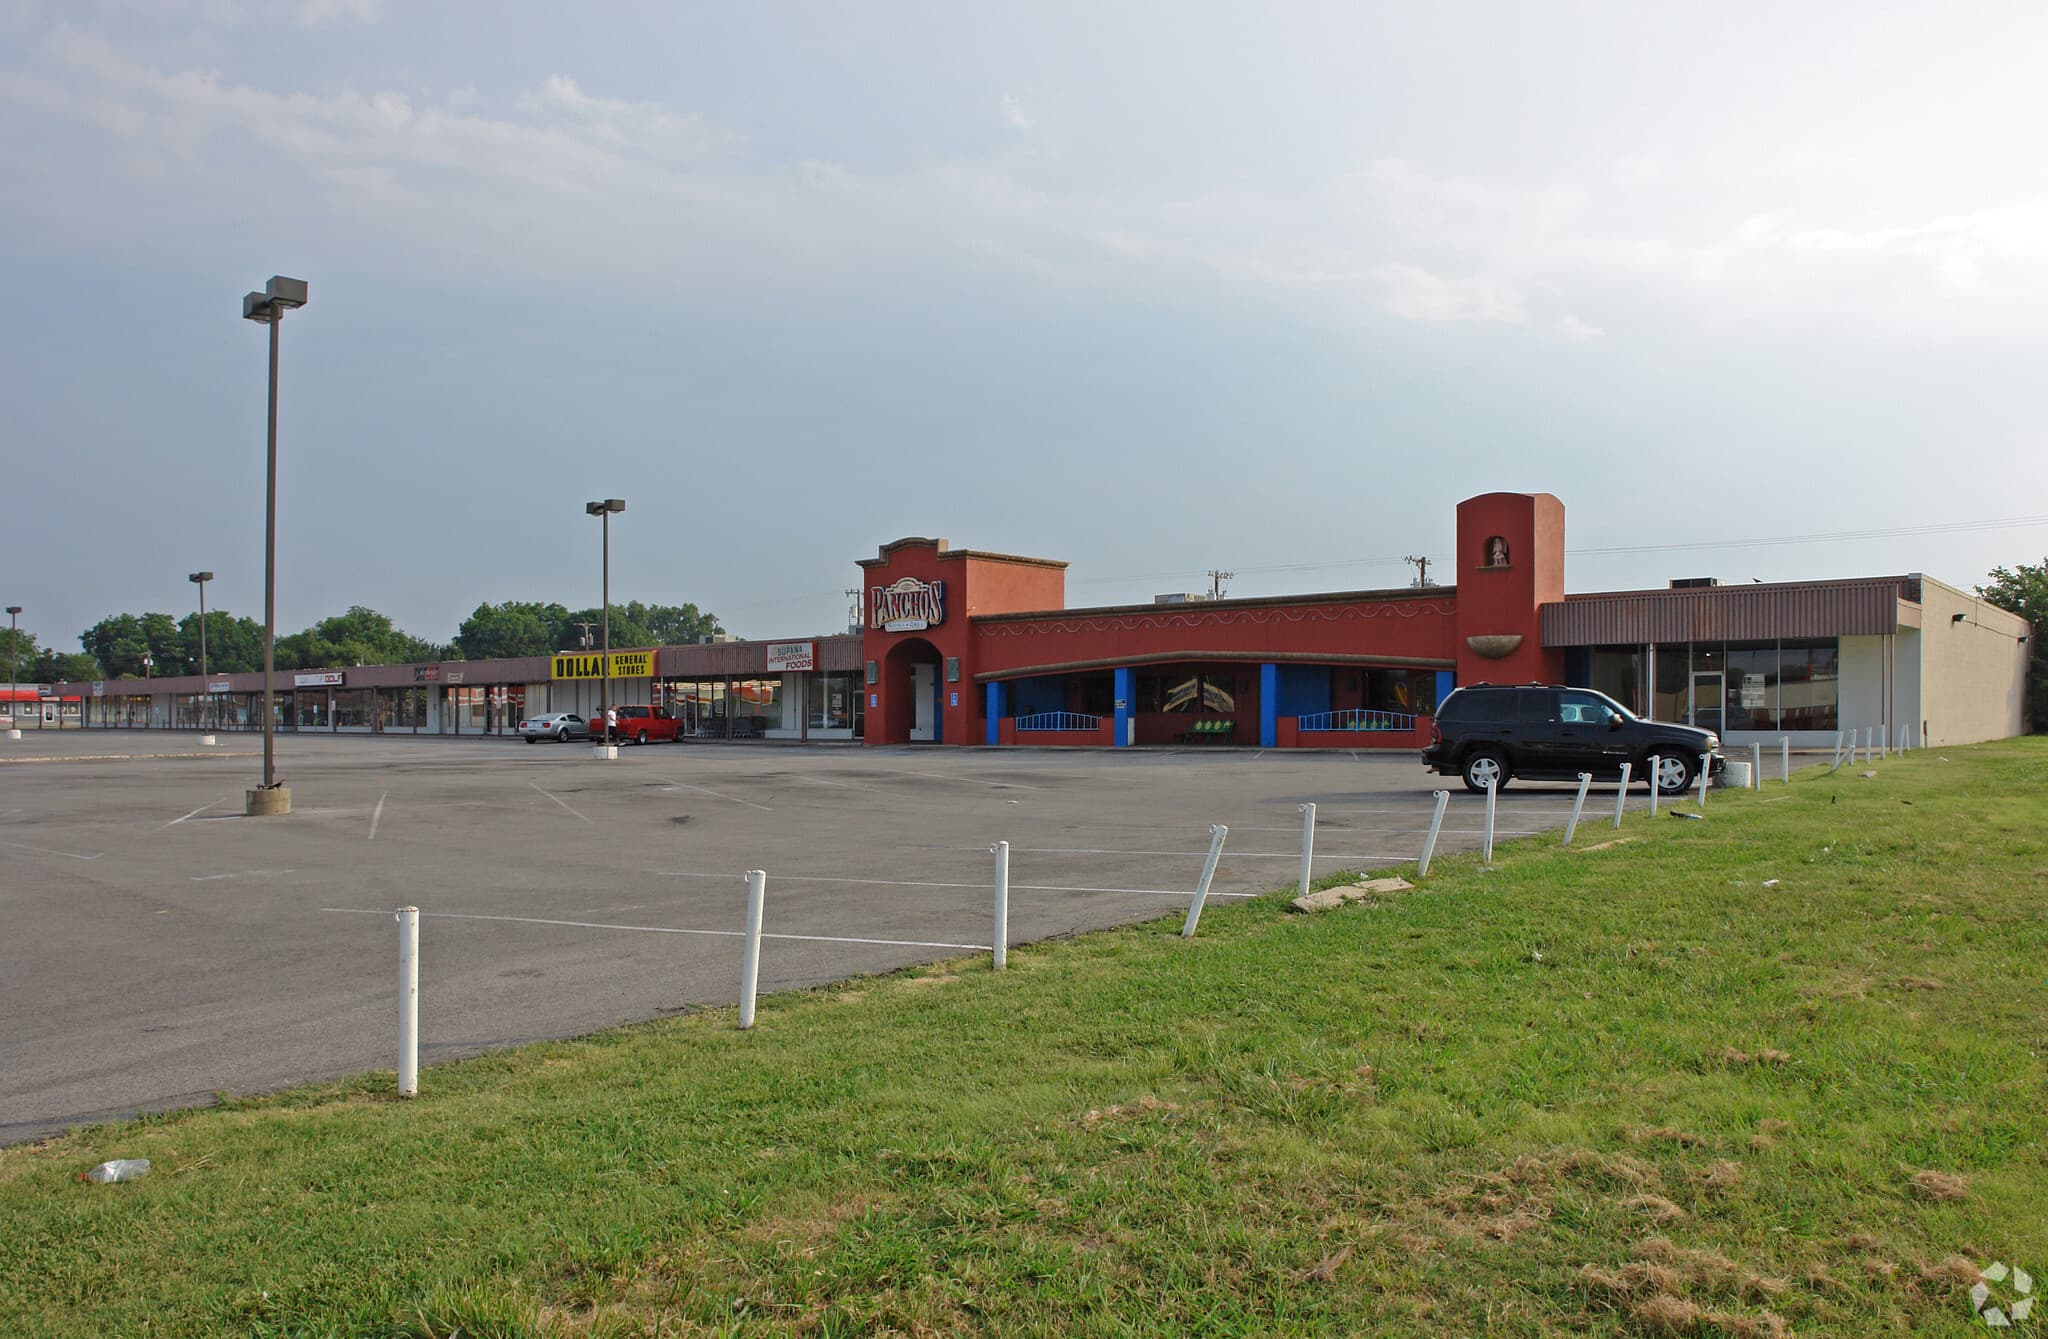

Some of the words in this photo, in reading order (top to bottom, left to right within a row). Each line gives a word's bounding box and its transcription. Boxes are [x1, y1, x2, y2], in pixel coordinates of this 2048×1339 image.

[871, 579, 942, 629] PANCHOS
[615, 654, 647, 665] GENERAL
[768, 651, 812, 664] INTERNATIONAL
[785, 659, 812, 670] FOODS
[618, 665, 645, 676] STORES
